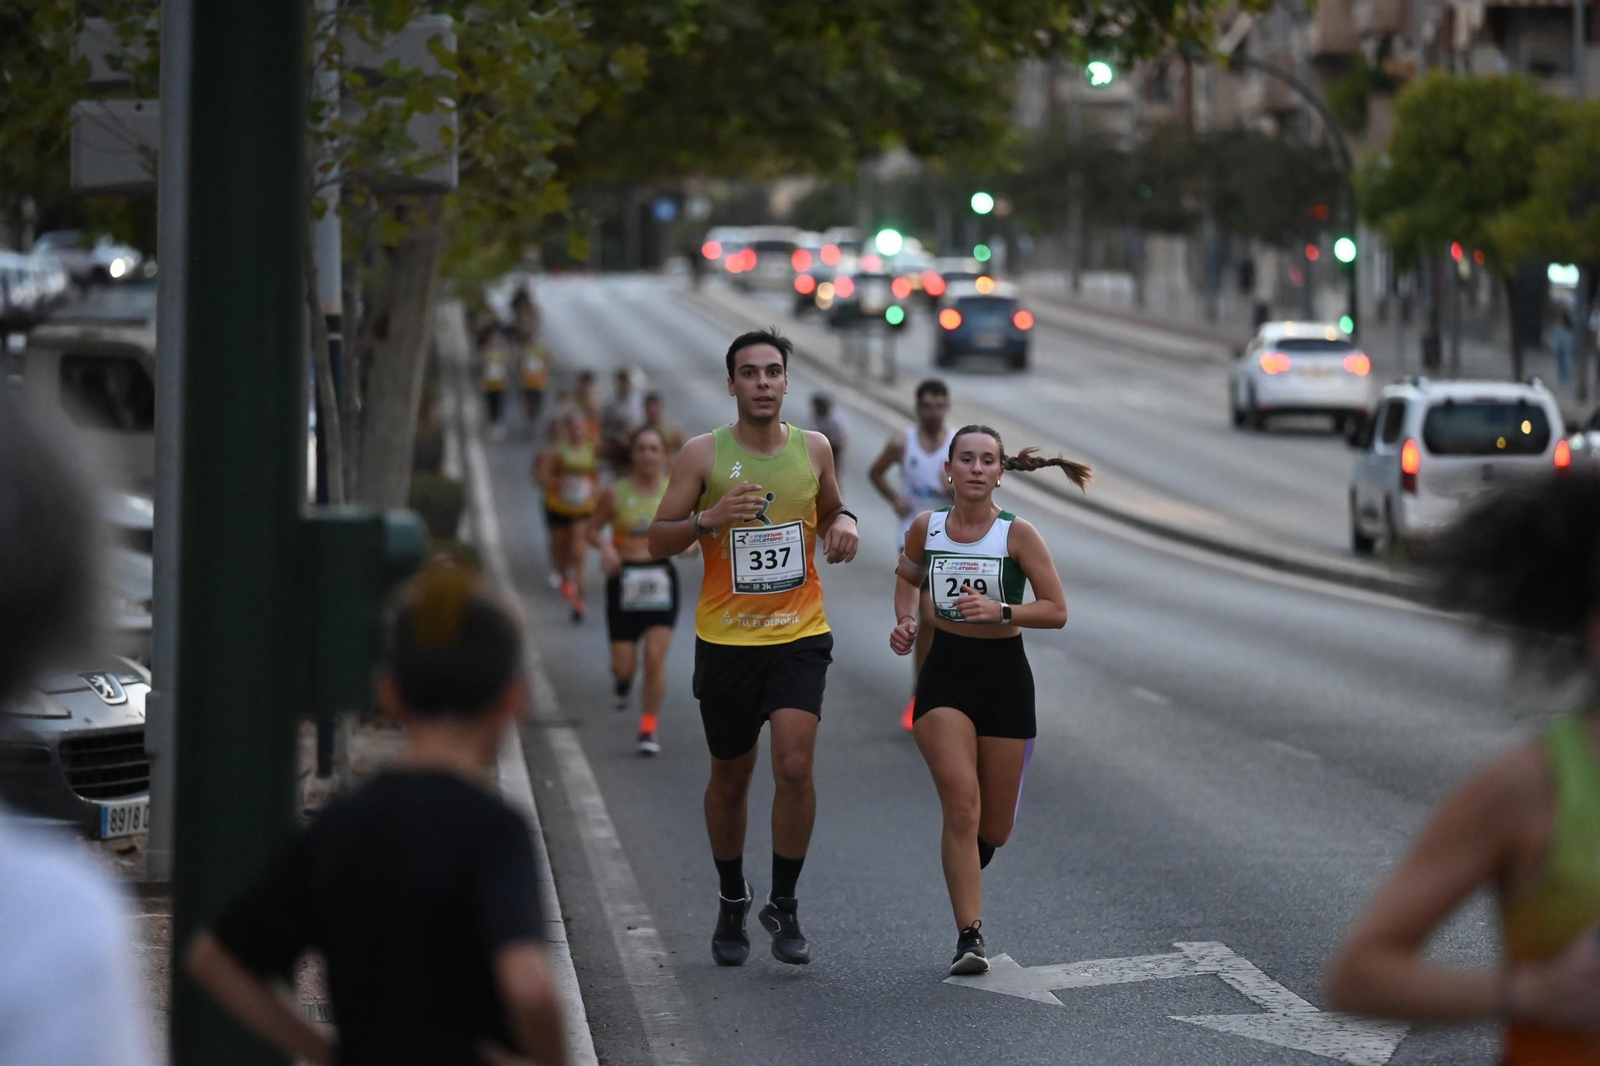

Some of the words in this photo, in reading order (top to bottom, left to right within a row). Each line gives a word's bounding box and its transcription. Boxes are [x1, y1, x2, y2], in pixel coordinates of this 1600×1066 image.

[749, 547, 791, 571] 337
[946, 577, 987, 597] 249
[110, 806, 141, 832] 8918
